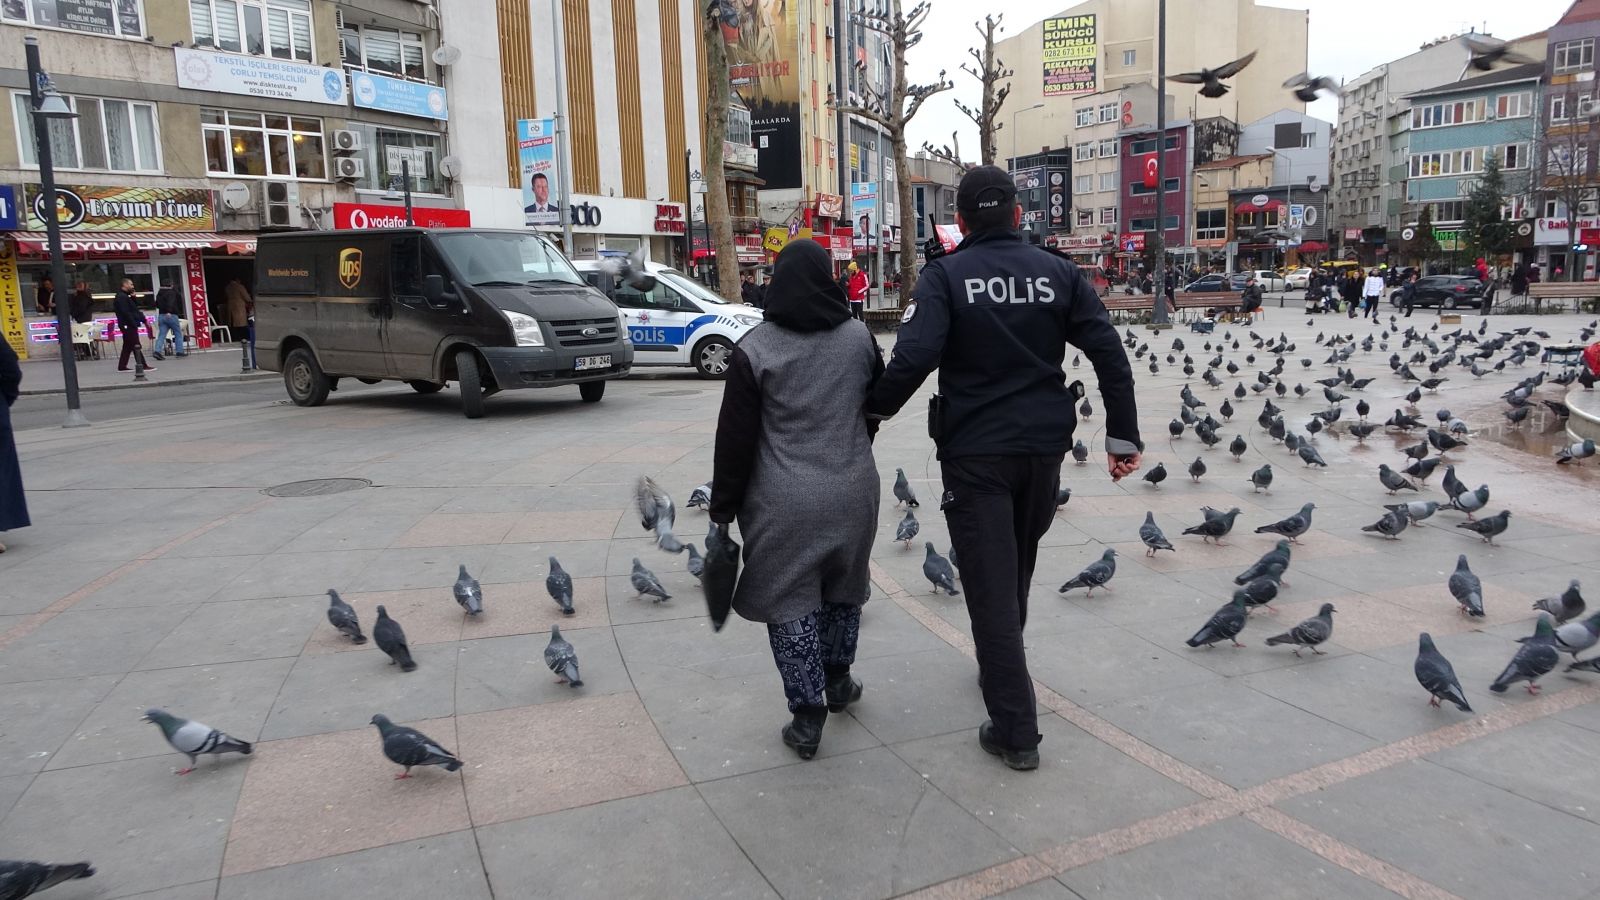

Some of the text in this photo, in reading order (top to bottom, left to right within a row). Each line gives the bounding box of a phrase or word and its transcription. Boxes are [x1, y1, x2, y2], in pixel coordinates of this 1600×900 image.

[1044, 28, 1094, 40] SÜRÜCÜ
[1045, 37, 1094, 48] KURSU
[214, 56, 246, 67] TEKSTİL
[282, 64, 320, 76] SENDİKASI
[231, 68, 307, 84] ÇORLU TEMSİLCİLİĞİ
[90, 198, 204, 218] Doyum Döner
[1548, 220, 1592, 230] Balknlar
[341, 260, 359, 282] ups
